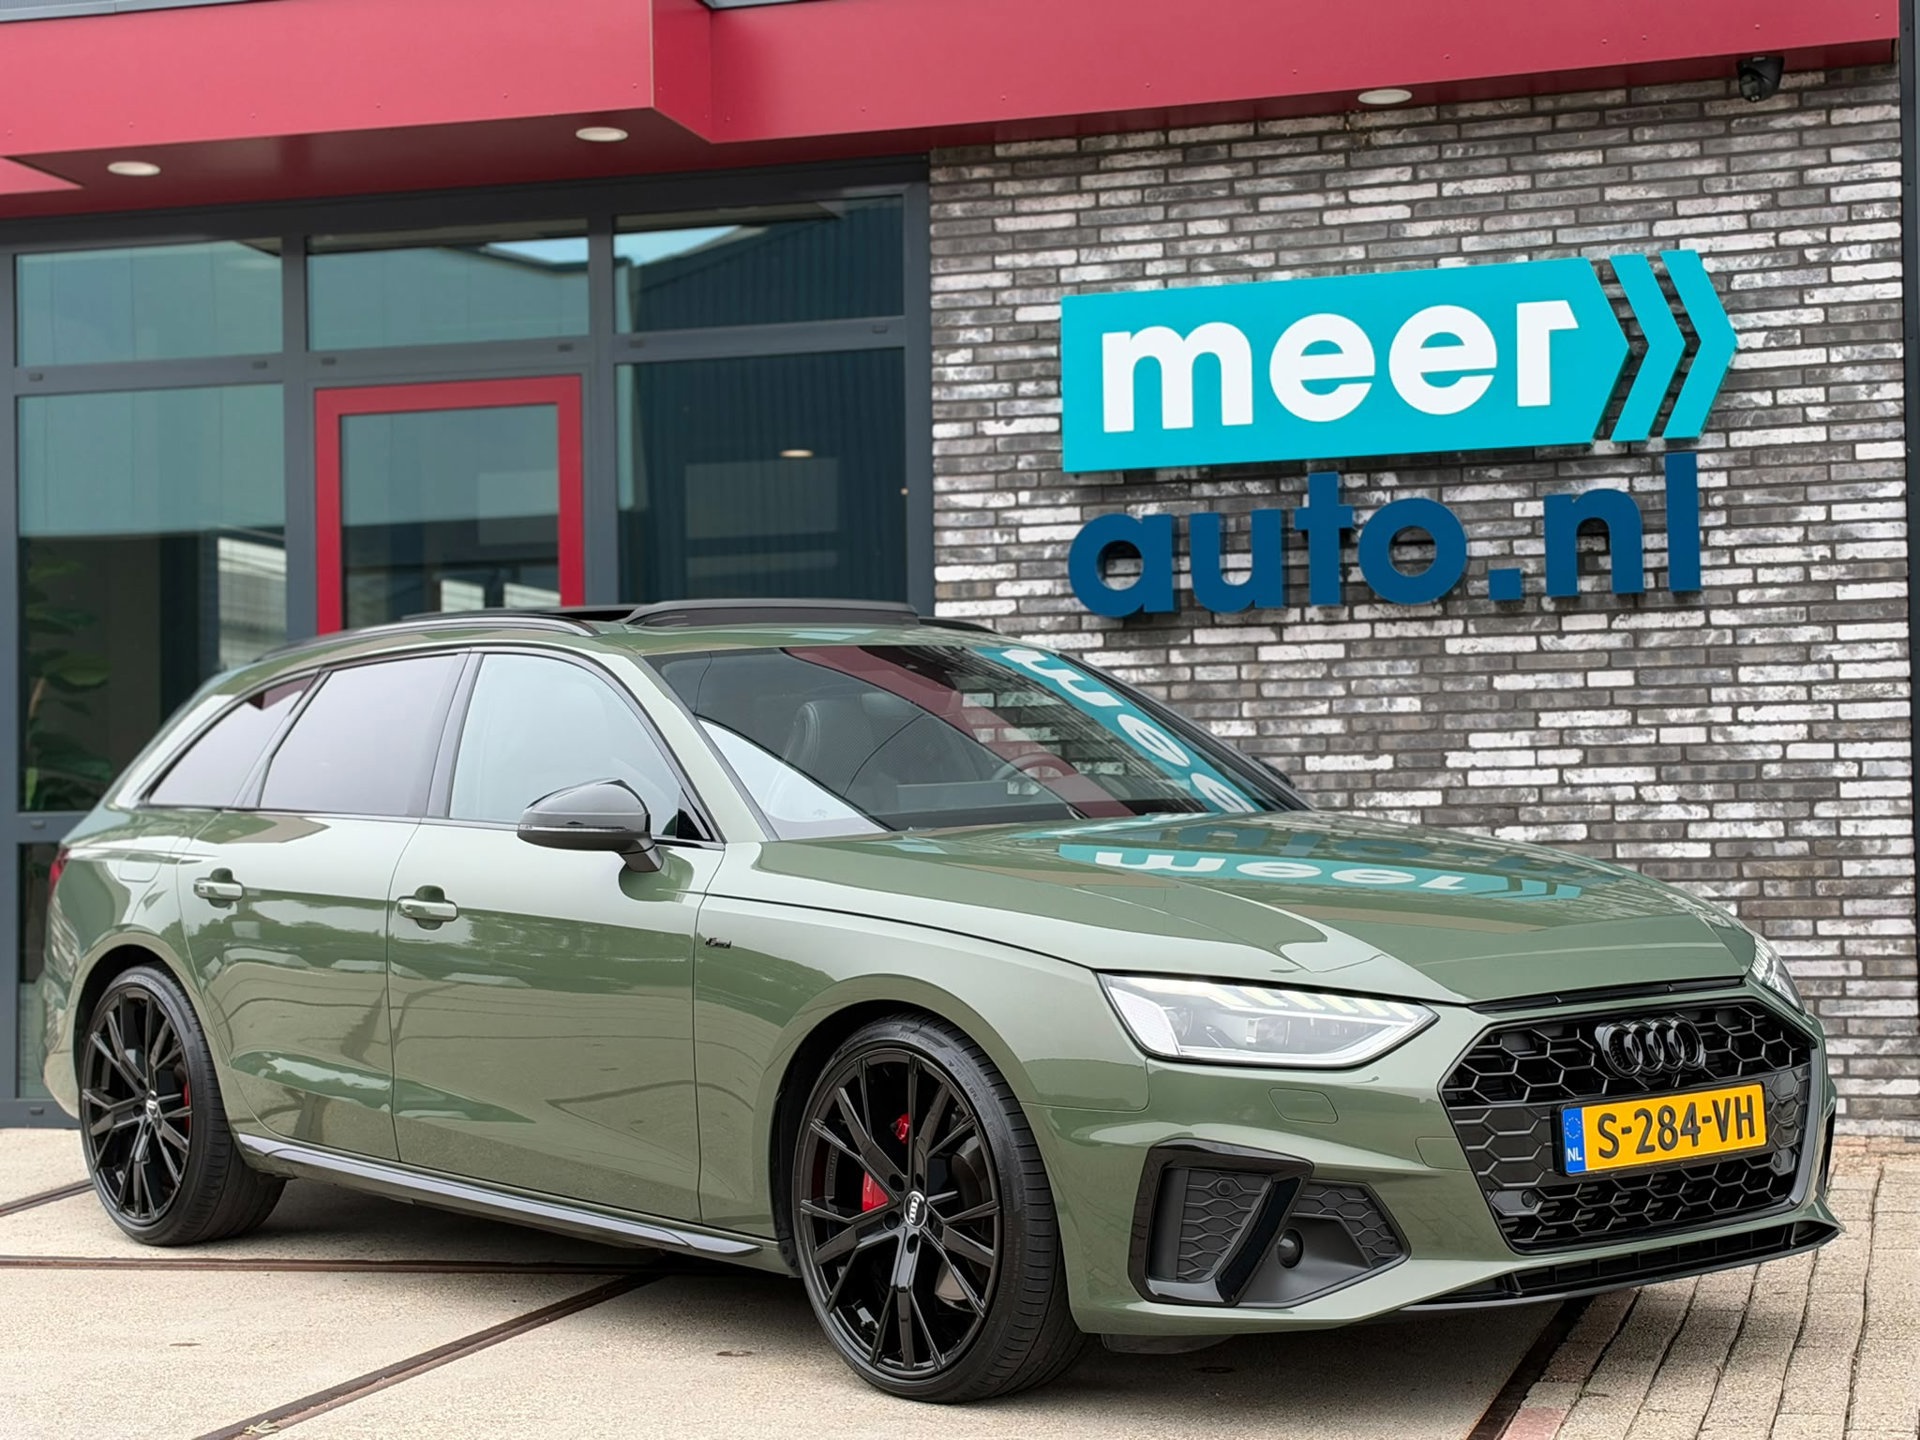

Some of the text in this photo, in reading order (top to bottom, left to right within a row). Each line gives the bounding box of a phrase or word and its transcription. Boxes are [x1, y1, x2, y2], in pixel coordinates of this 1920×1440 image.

[1102, 299, 1579, 433] meer
[1067, 452, 1700, 617] auto.nl
[1567, 1147, 1583, 1162] NL
[1598, 1094, 1756, 1159] S-284-VH
